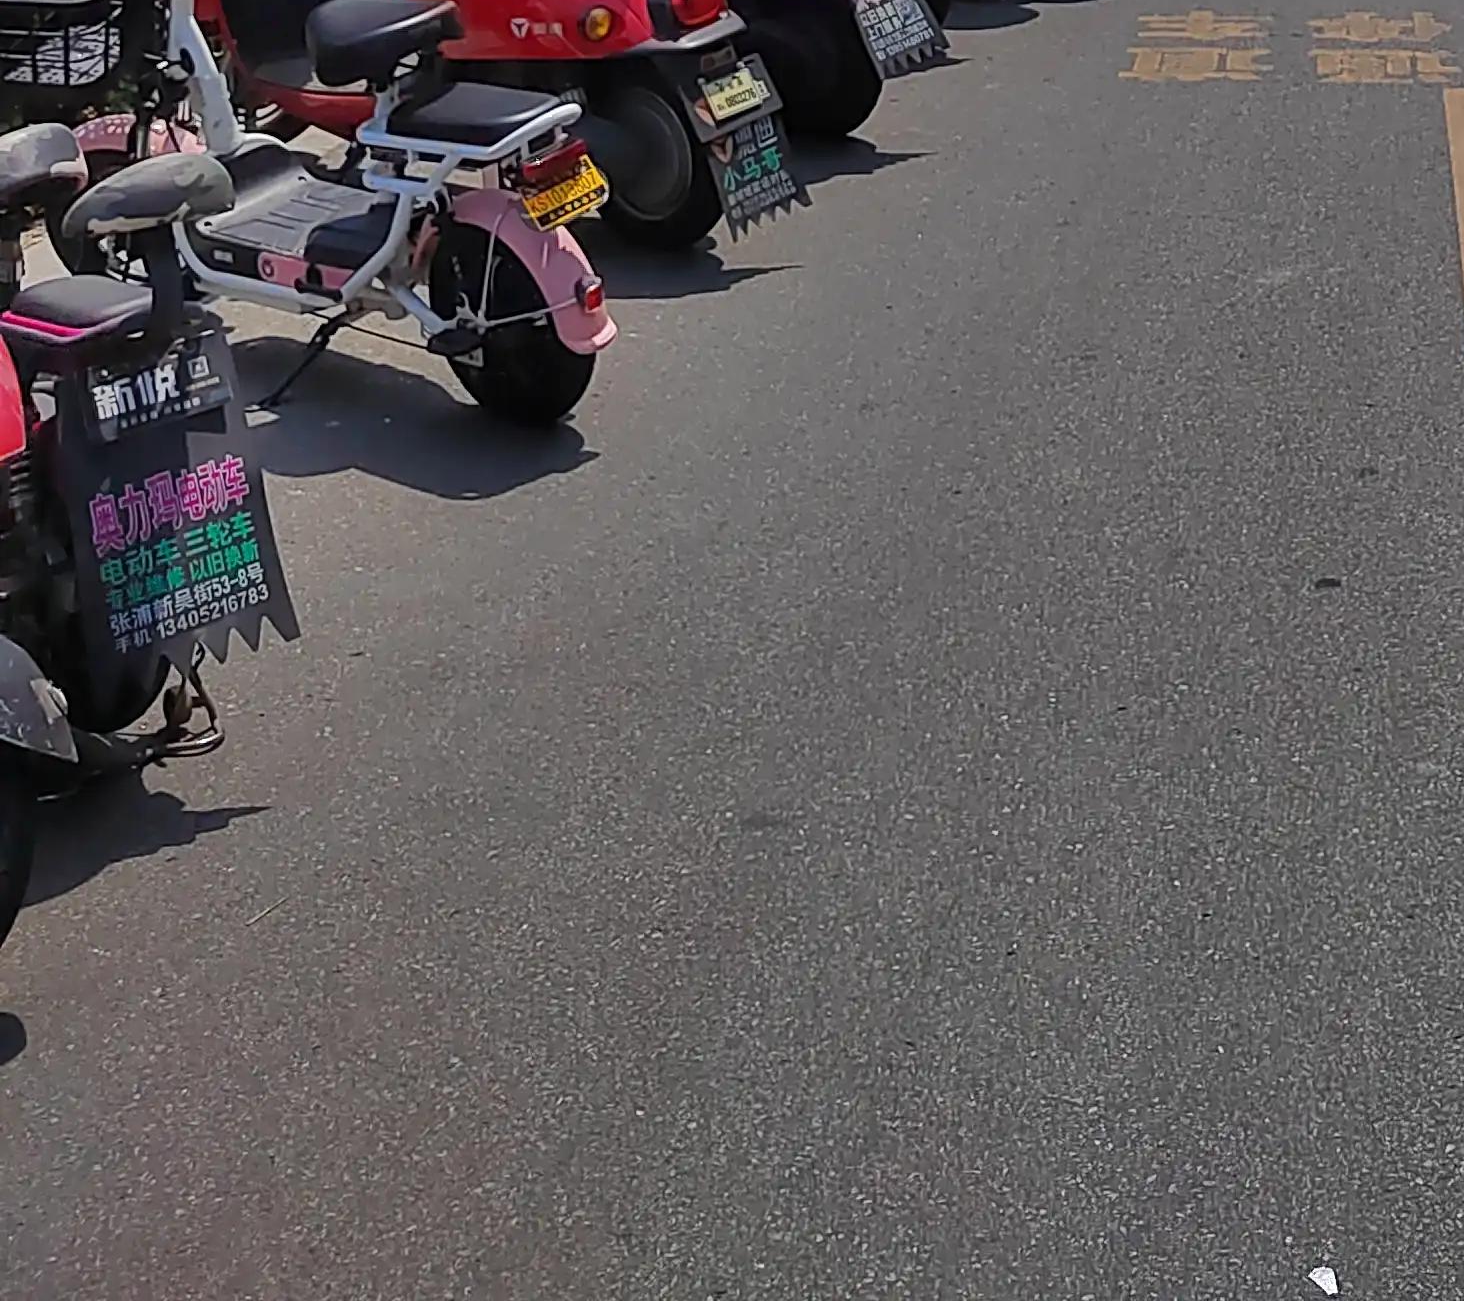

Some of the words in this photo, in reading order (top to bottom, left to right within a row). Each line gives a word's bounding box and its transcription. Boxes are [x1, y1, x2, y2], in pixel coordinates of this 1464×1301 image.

[88, 453, 251, 558] 奥力玛电动车
[101, 536, 182, 585] 电动车
[183, 511, 256, 557] 三轮车
[189, 537, 260, 581] 以旧换新
[115, 627, 153, 654] 手机
[156, 583, 270, 640] 13405216783
